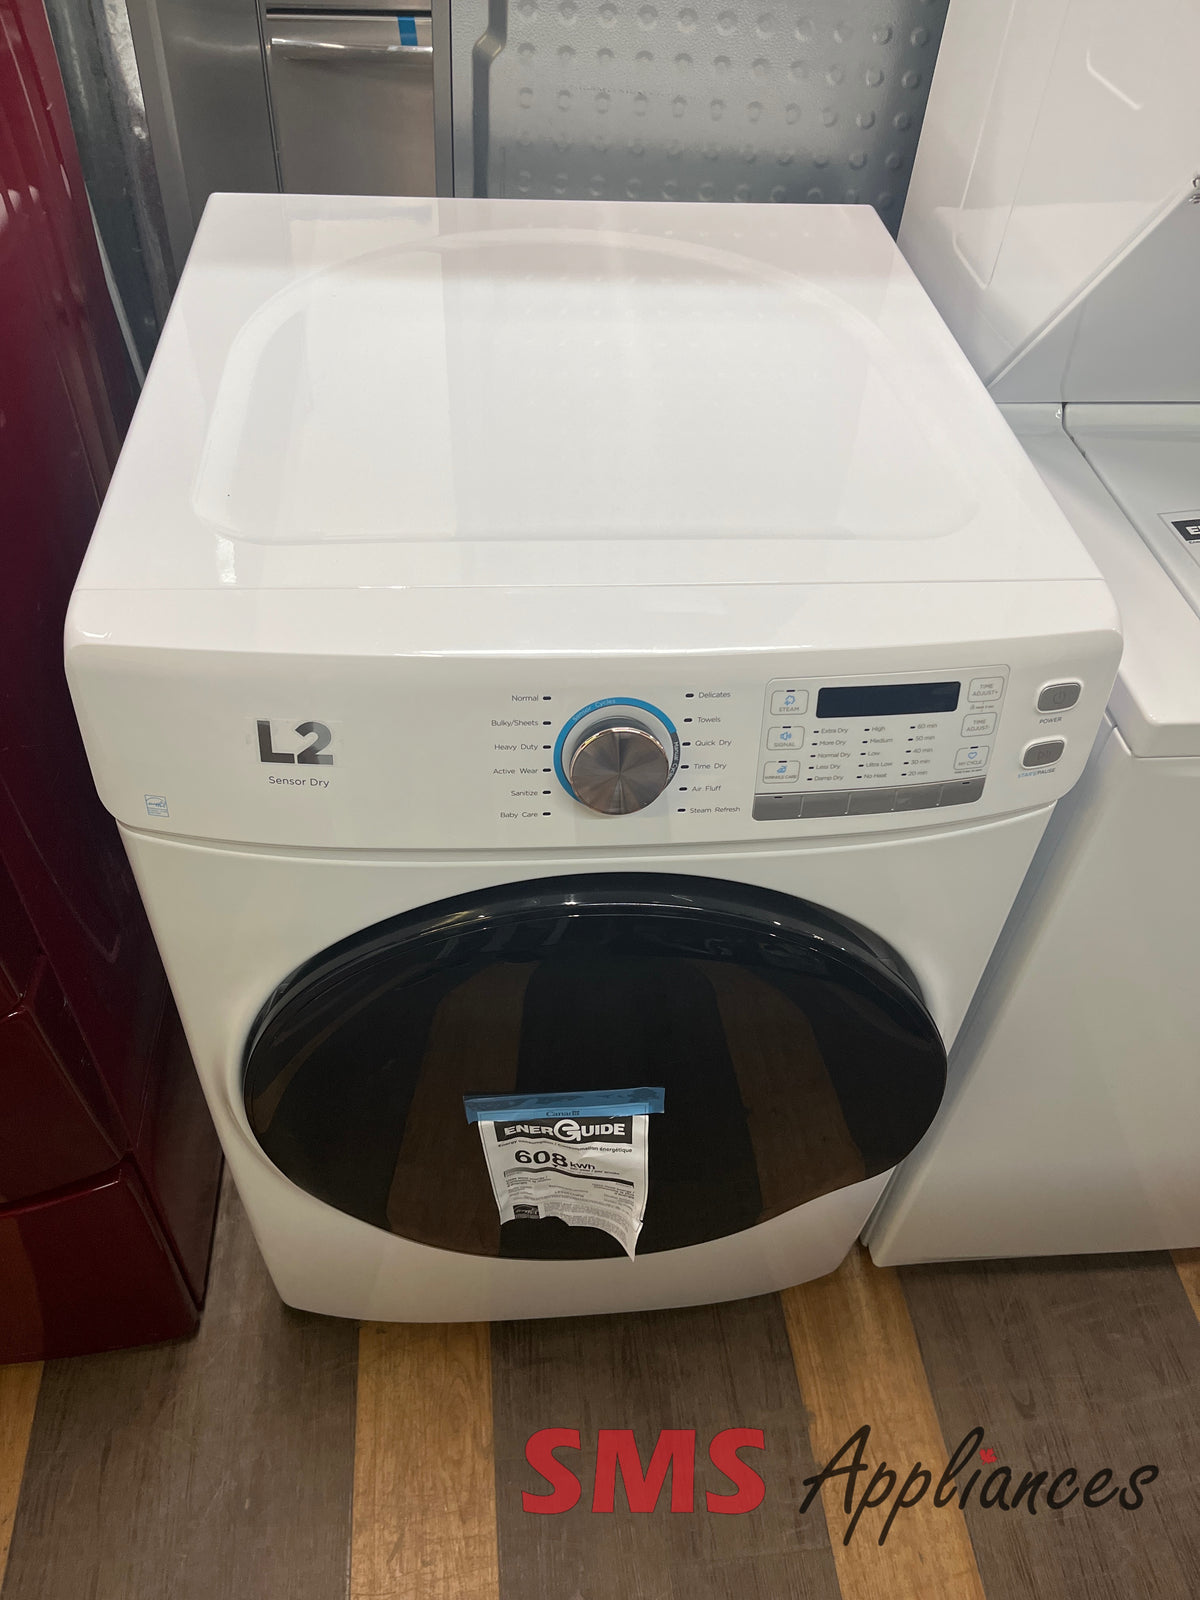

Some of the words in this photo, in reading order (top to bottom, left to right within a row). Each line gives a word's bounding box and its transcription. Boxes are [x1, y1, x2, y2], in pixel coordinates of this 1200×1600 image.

[511, 694, 539, 702] Normal
[698, 691, 731, 699] Delicates
[491, 719, 539, 727] Bulky/Sheets
[697, 716, 721, 724] Towels
[1039, 716, 1063, 724] POWER
[837, 727, 849, 735] Dry
[871, 725, 886, 733] High
[256, 719, 334, 766] L2
[719, 739, 732, 747] Dry
[835, 739, 847, 747] Dry
[494, 744, 518, 752] Heavy
[520, 743, 539, 752] Duty
[840, 751, 851, 759] Dry
[713, 762, 727, 770] Dry
[815, 763, 829, 771] Less
[830, 762, 841, 771] Dry
[519, 767, 538, 775] Wear
[268, 775, 306, 787] Sensor
[309, 777, 330, 789] Dry
[814, 775, 832, 783] Damp
[833, 774, 844, 782] Dry
[500, 811, 518, 819] Baby
[503, 1118, 626, 1142] ENERGUIDE
[514, 1149, 569, 1168] 608
